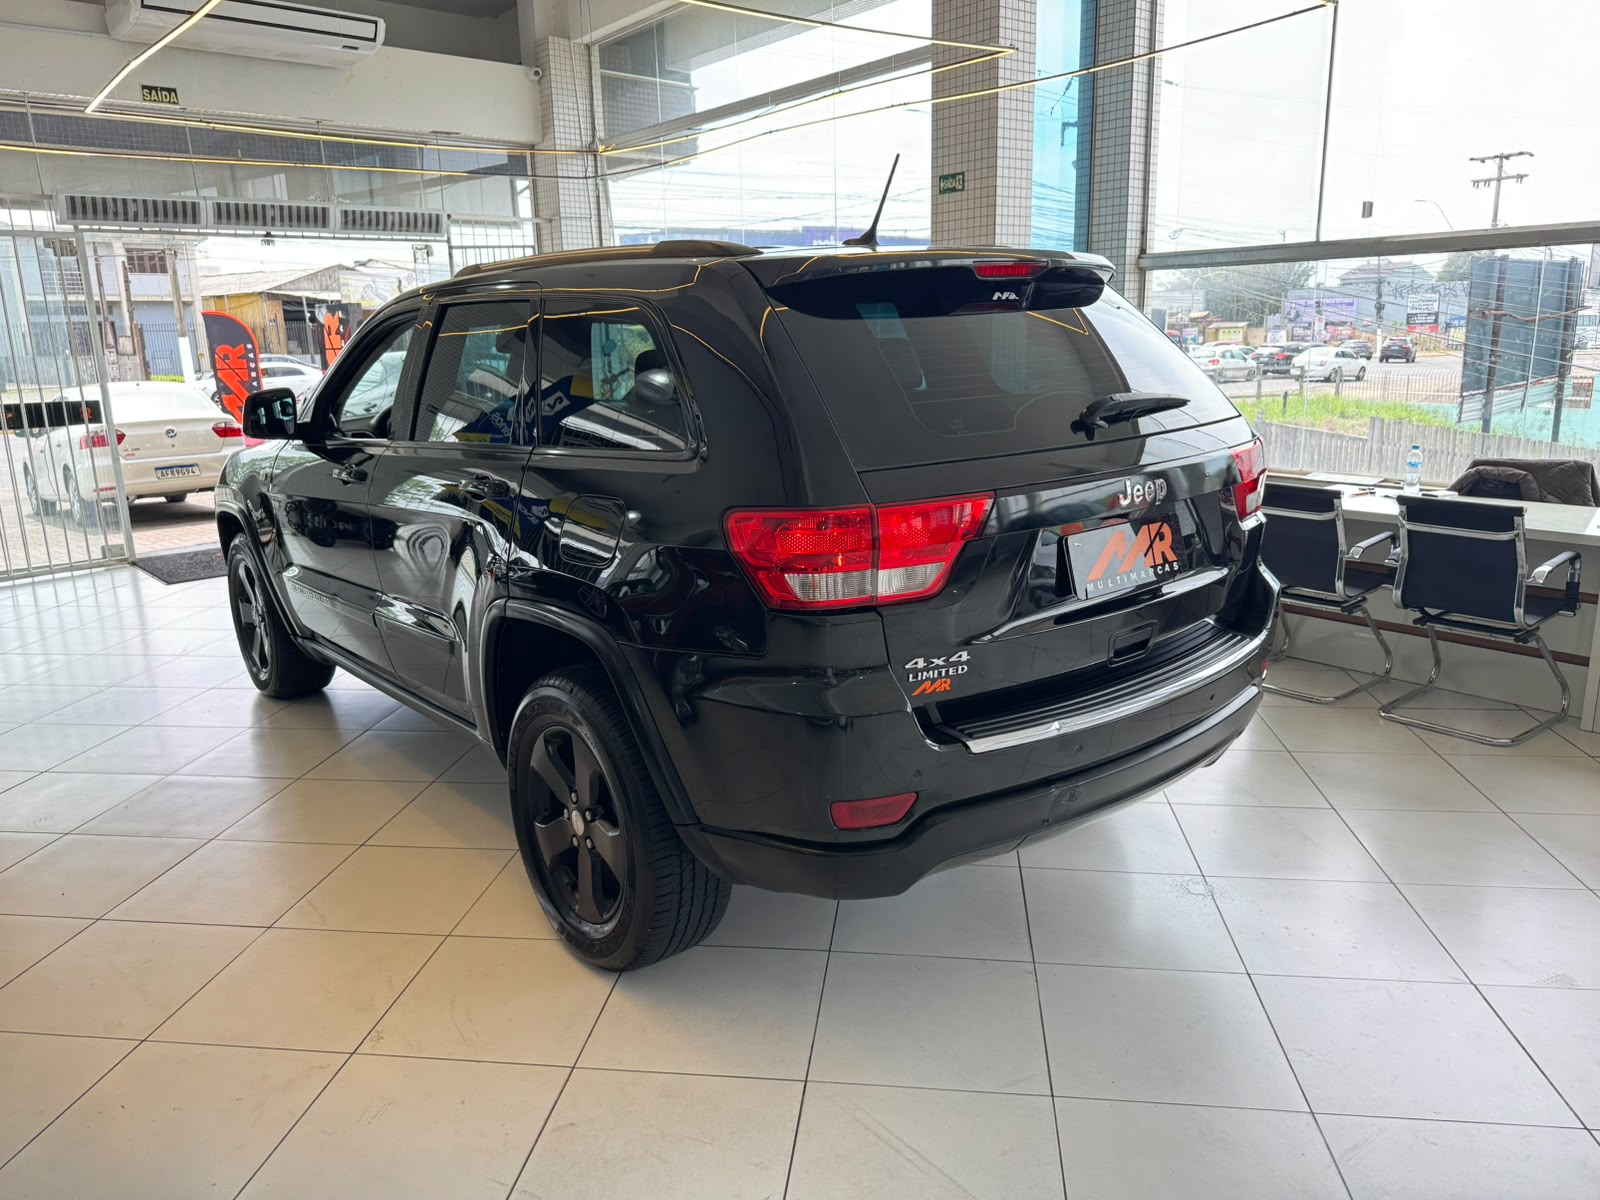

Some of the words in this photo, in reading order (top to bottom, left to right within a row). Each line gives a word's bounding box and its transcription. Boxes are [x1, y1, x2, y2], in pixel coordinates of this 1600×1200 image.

[143, 87, 178, 104] SAÍDA
[1118, 478, 1168, 507] Jeep
[1086, 561, 1180, 592] MULTIMARCAS
[904, 650, 971, 669] 4x4
[908, 664, 969, 682] LIMITED
